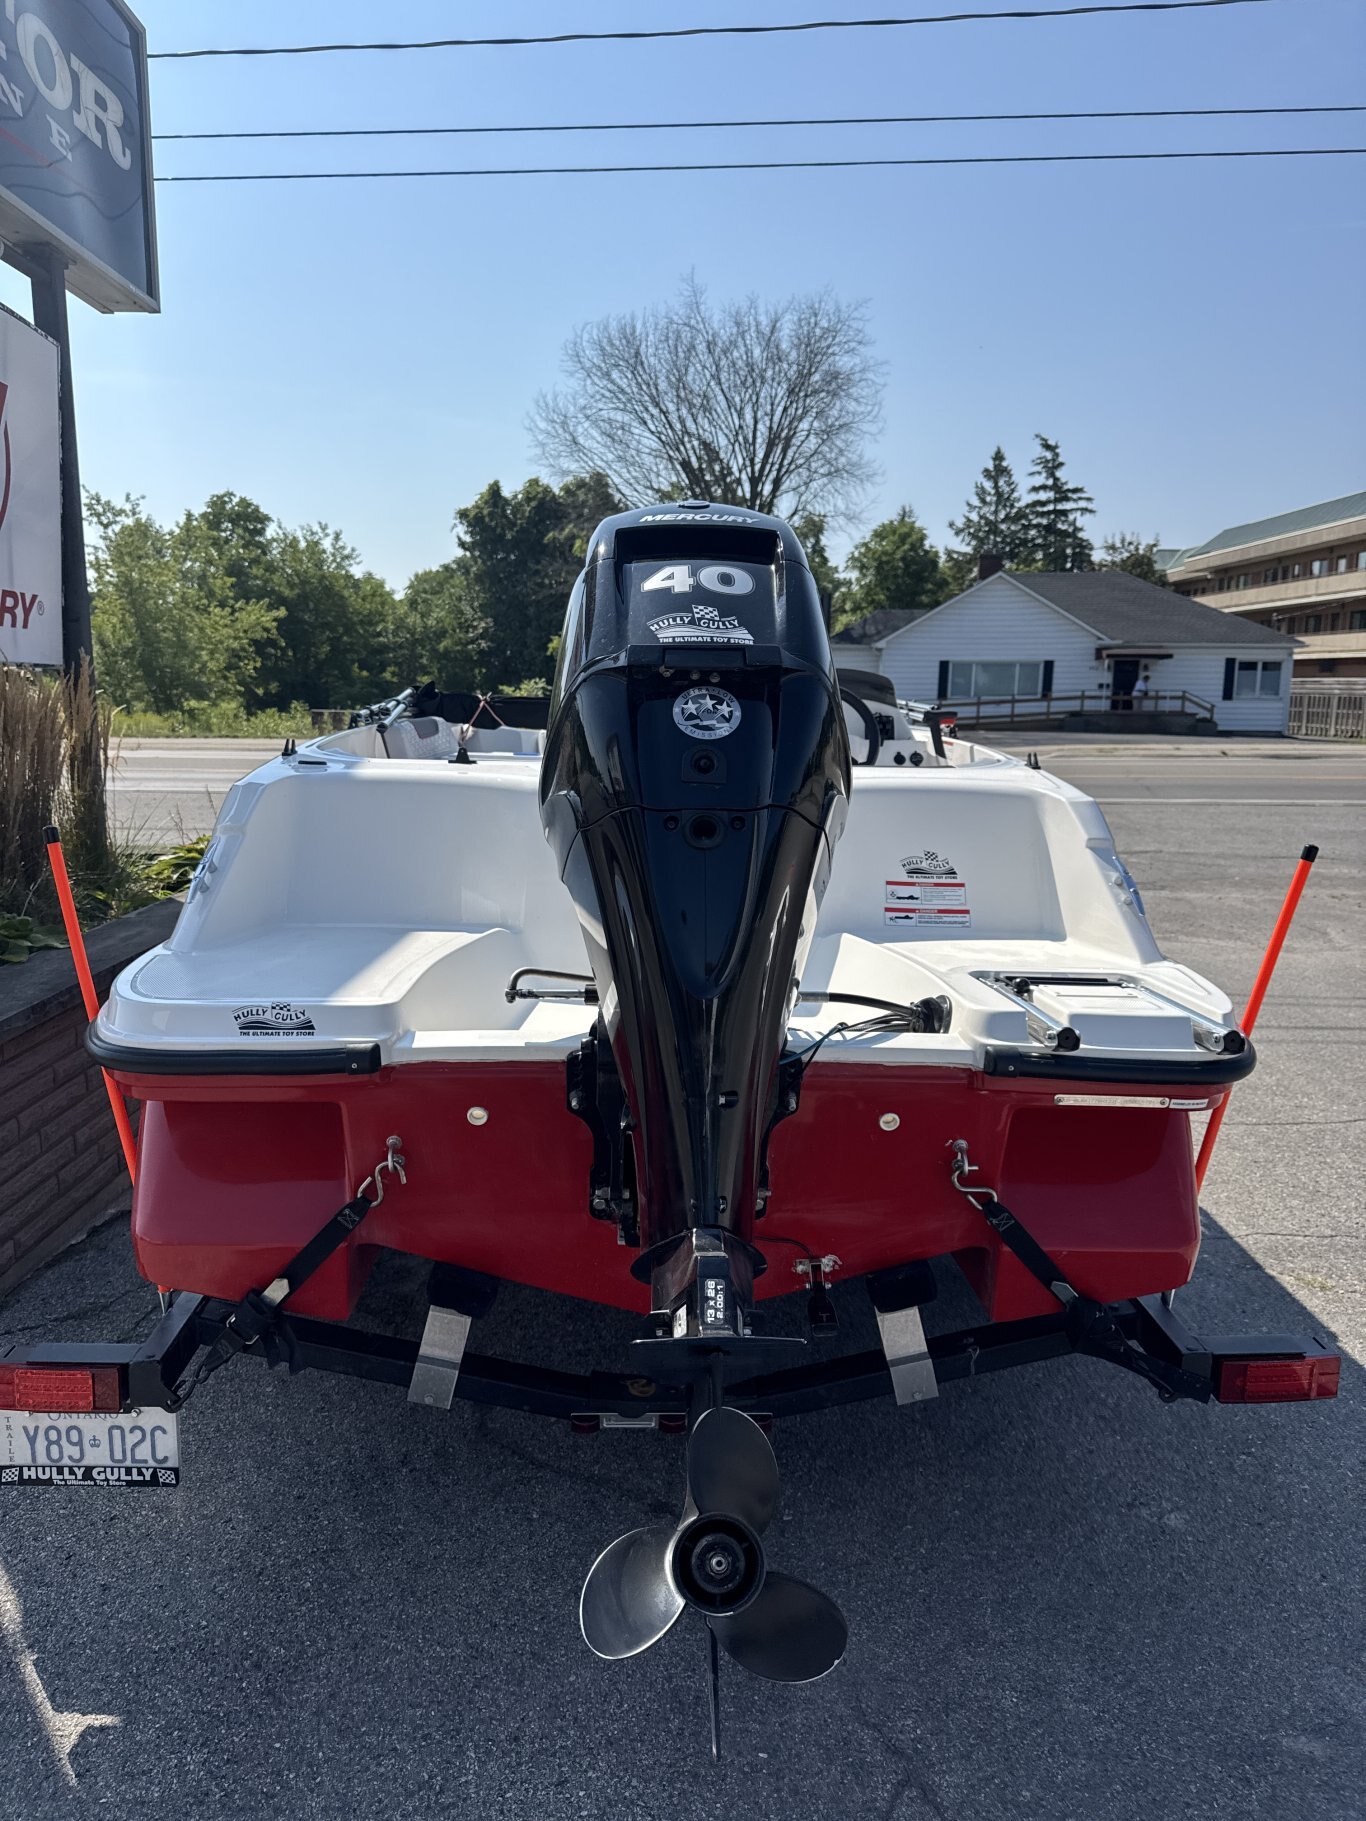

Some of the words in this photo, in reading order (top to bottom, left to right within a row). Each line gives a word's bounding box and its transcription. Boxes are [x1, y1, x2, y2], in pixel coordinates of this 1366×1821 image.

[639, 513, 760, 525] MERCURY
[641, 565, 756, 596] 40
[649, 616, 692, 632] HULLY
[901, 859, 924, 869] HULLY
[233, 1008, 268, 1022] HULLY
[274, 1009, 306, 1022] GULLY
[707, 1309, 715, 1323] 13
[4, 1416, 16, 1466] TRAILE
[22, 1425, 85, 1464] Y89
[108, 1425, 169, 1465] 02C
[23, 1466, 86, 1480] HULLY
[92, 1467, 154, 1481] GULLY
